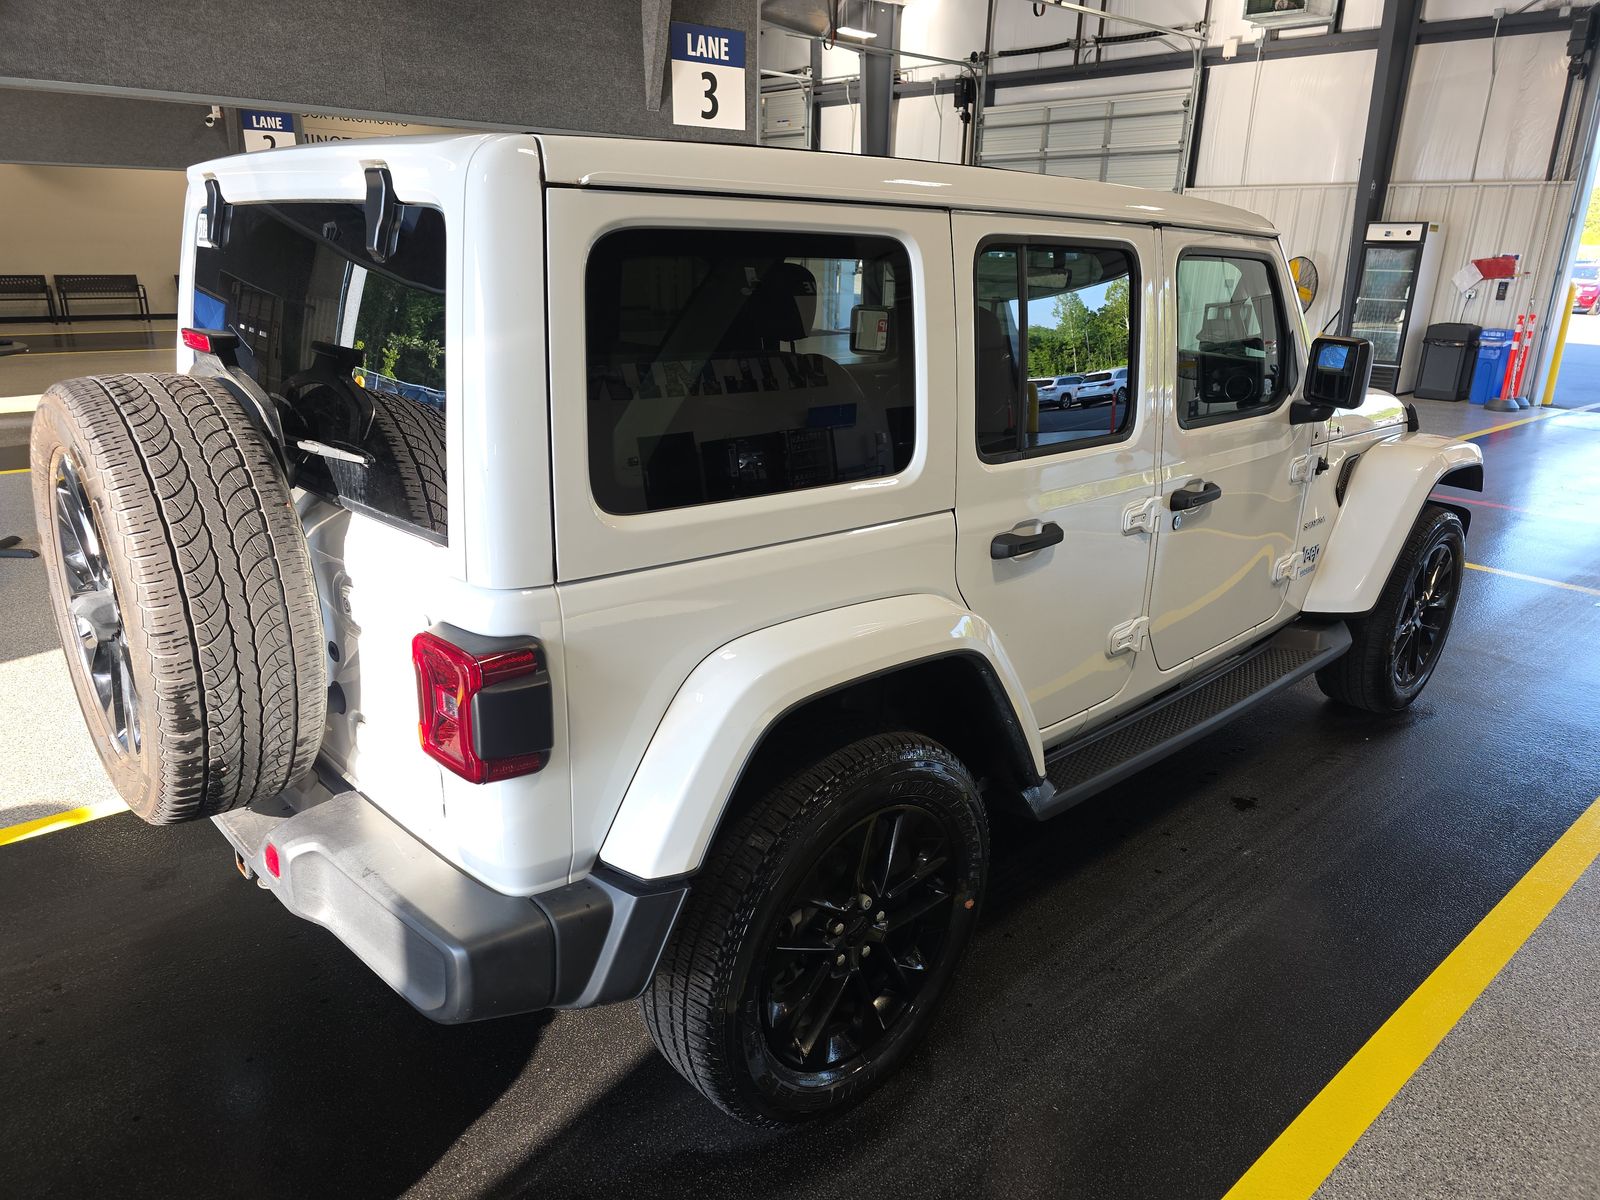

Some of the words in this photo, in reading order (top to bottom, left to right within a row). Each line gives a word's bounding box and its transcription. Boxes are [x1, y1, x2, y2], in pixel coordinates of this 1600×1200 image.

[686, 32, 730, 61] LANE
[701, 71, 719, 120] 3
[252, 115, 283, 129] LANE
